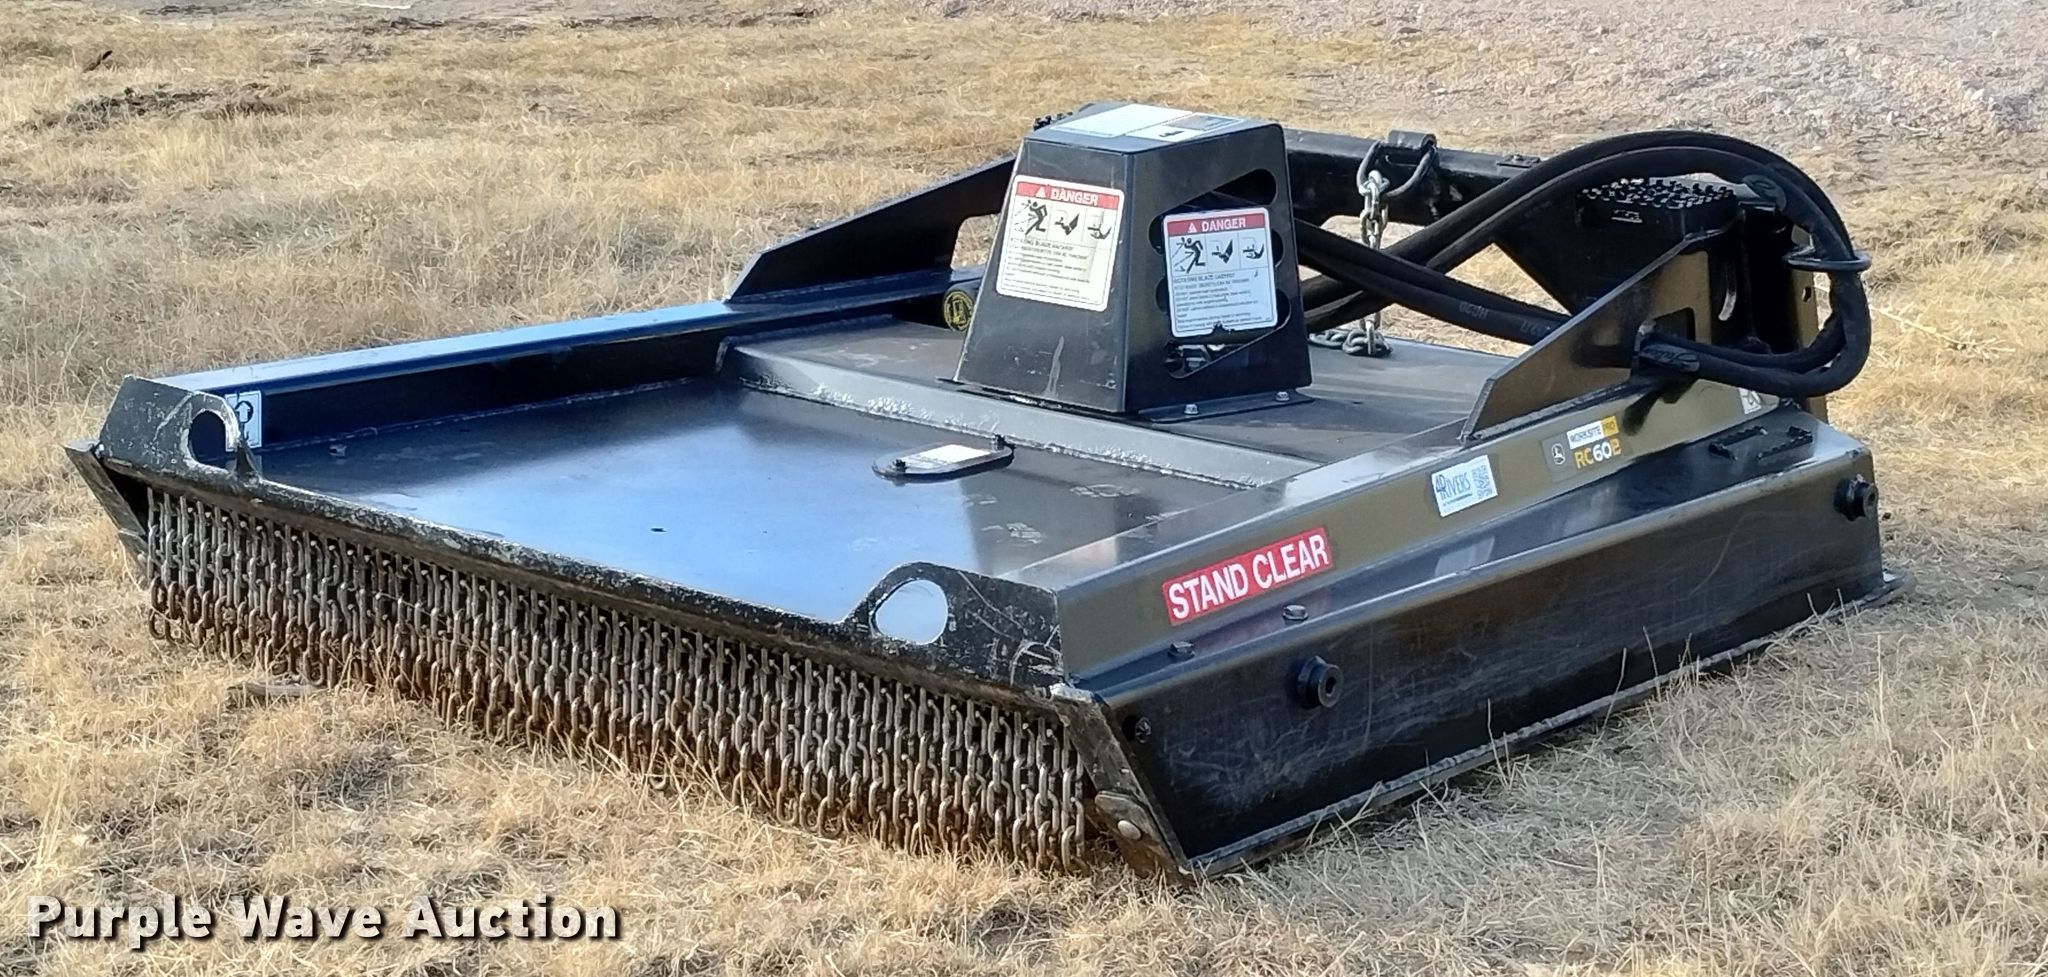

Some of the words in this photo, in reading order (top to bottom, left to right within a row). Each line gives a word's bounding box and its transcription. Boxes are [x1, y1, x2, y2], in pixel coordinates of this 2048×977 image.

[1050, 188, 1099, 206] DANGER
[1201, 217, 1246, 232] DANGER
[1168, 562, 1249, 619] STAND
[1252, 534, 1330, 589] CLEAR
